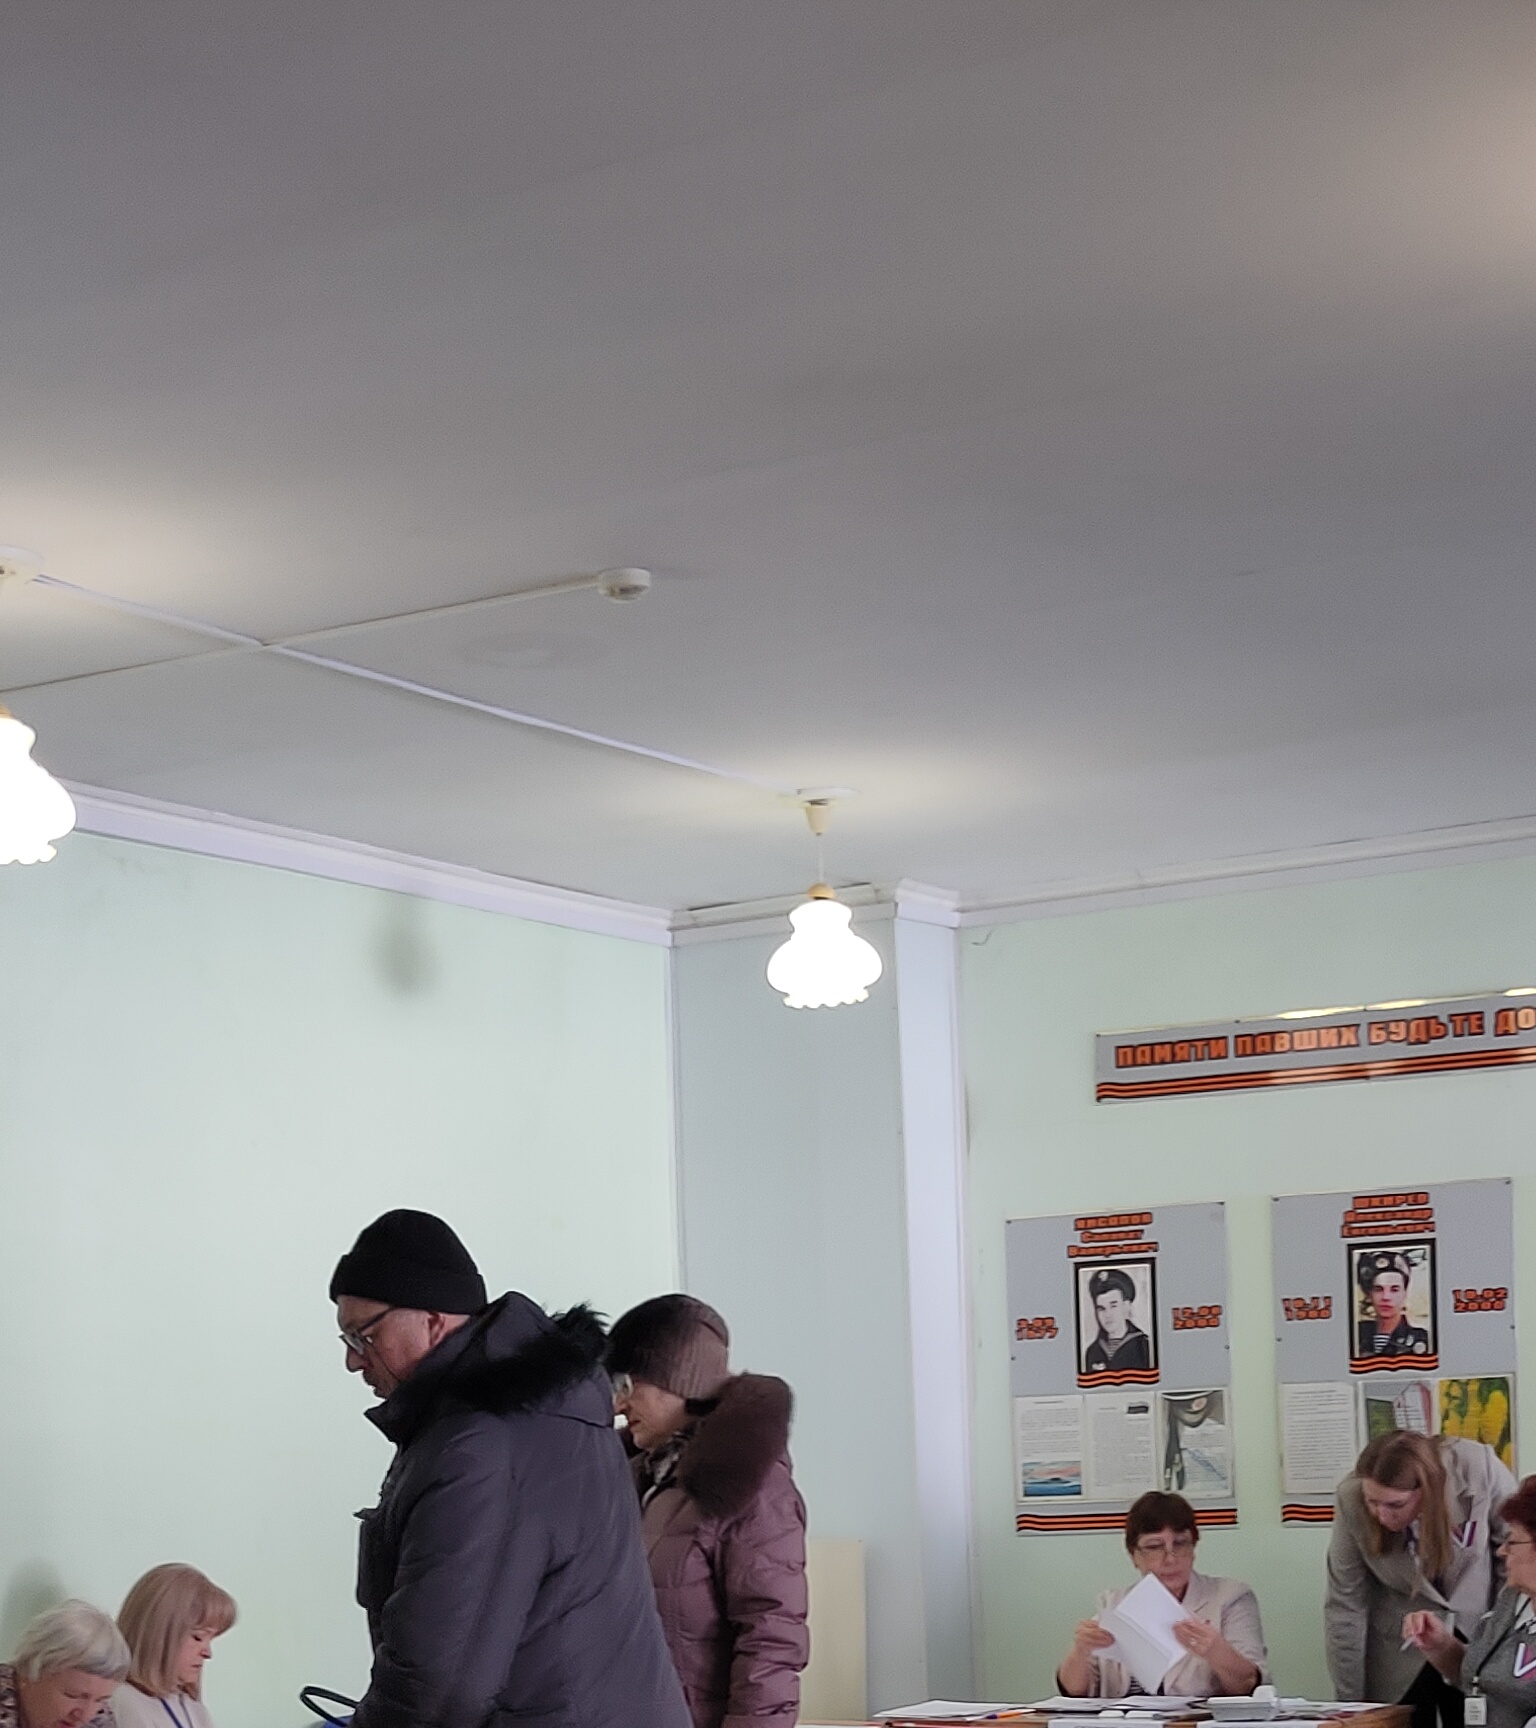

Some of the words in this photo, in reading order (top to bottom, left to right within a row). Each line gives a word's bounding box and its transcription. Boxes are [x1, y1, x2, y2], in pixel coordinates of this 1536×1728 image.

[1115, 1035, 1228, 1068] ПАМЯТИ
[1235, 1024, 1359, 1058] ПАВШИХ
[1368, 1012, 1485, 1045] БУДЬТЕ
[1453, 1299, 1506, 1313] 2000
